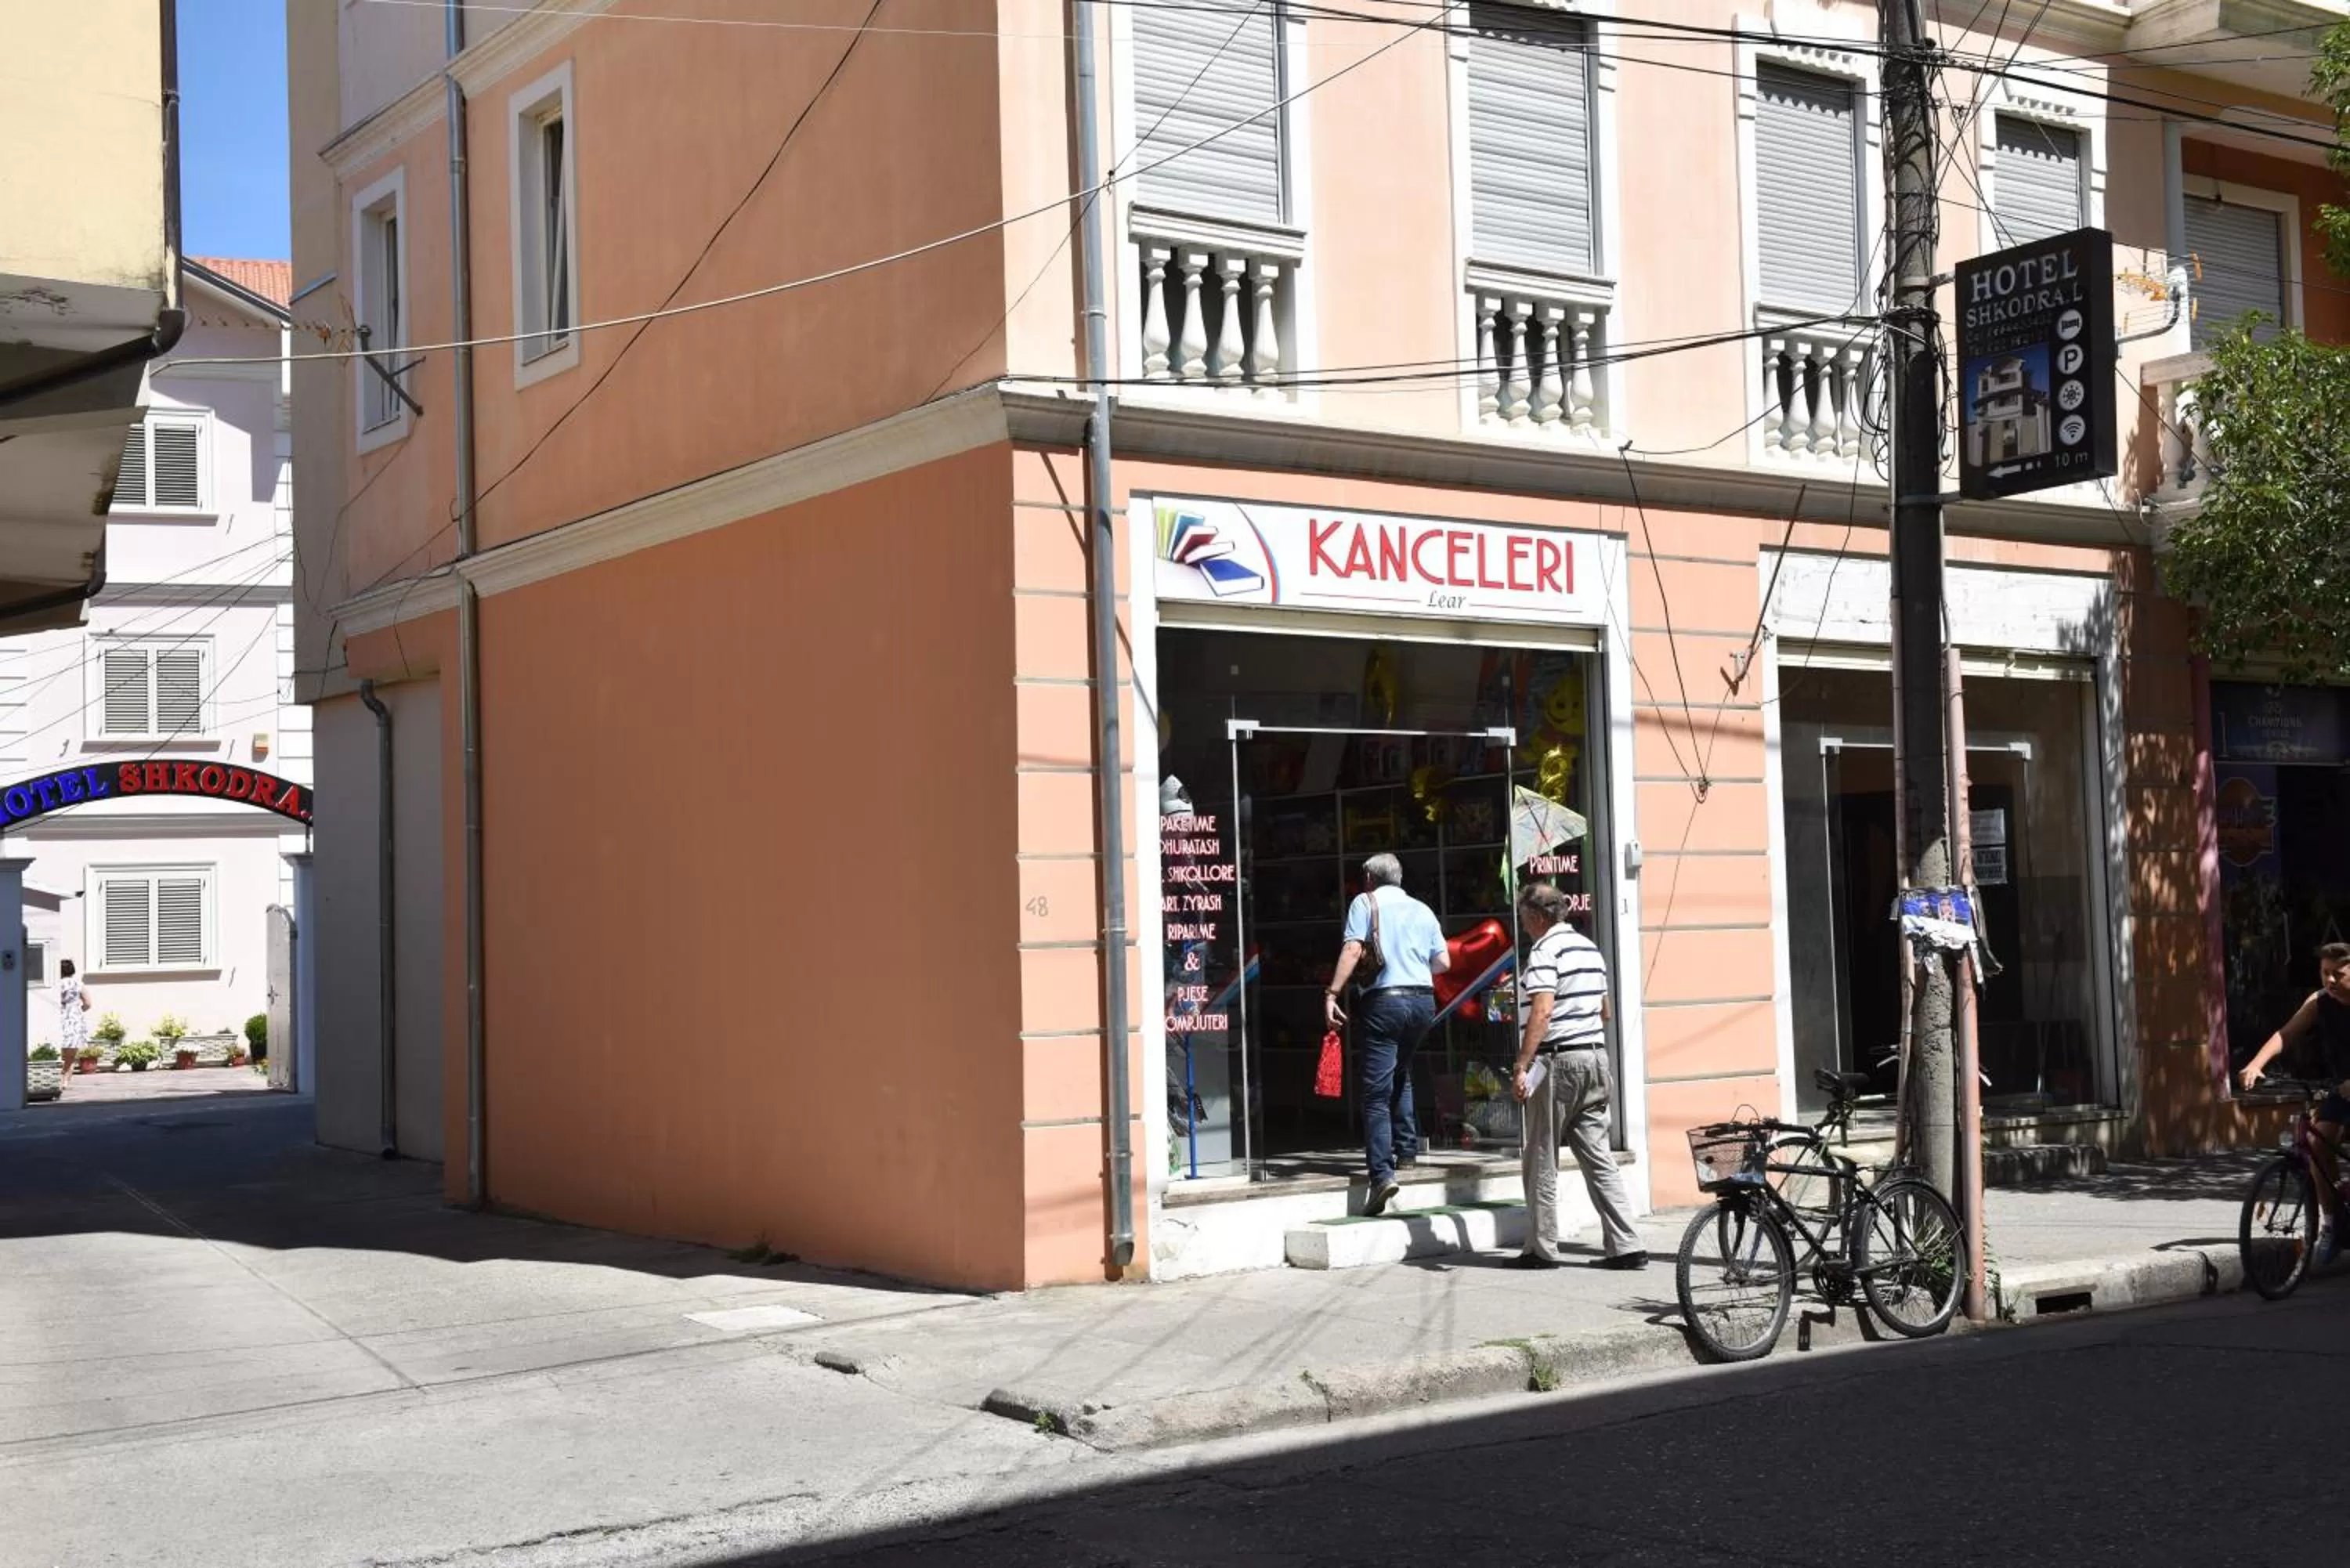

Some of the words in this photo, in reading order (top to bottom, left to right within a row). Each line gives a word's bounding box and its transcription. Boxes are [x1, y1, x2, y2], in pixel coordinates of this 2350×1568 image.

[1971, 249, 2078, 302] HOTEL
[1309, 518, 1574, 594] KANCELERI
[1426, 589, 1467, 609] Lear
[1160, 815, 1217, 833] PAKETIME
[1530, 854, 1578, 873] PRINTIME
[1168, 864, 1235, 882] SHKOLLORE
[1025, 895, 1050, 917] 48
[1182, 894, 1222, 912] ZYRASH
[1167, 923, 1217, 941] RIPARIME
[1184, 952, 1201, 971] &
[1177, 985, 1209, 1002] PJESE
[1165, 1014, 1228, 1031] OMPJUTERI
